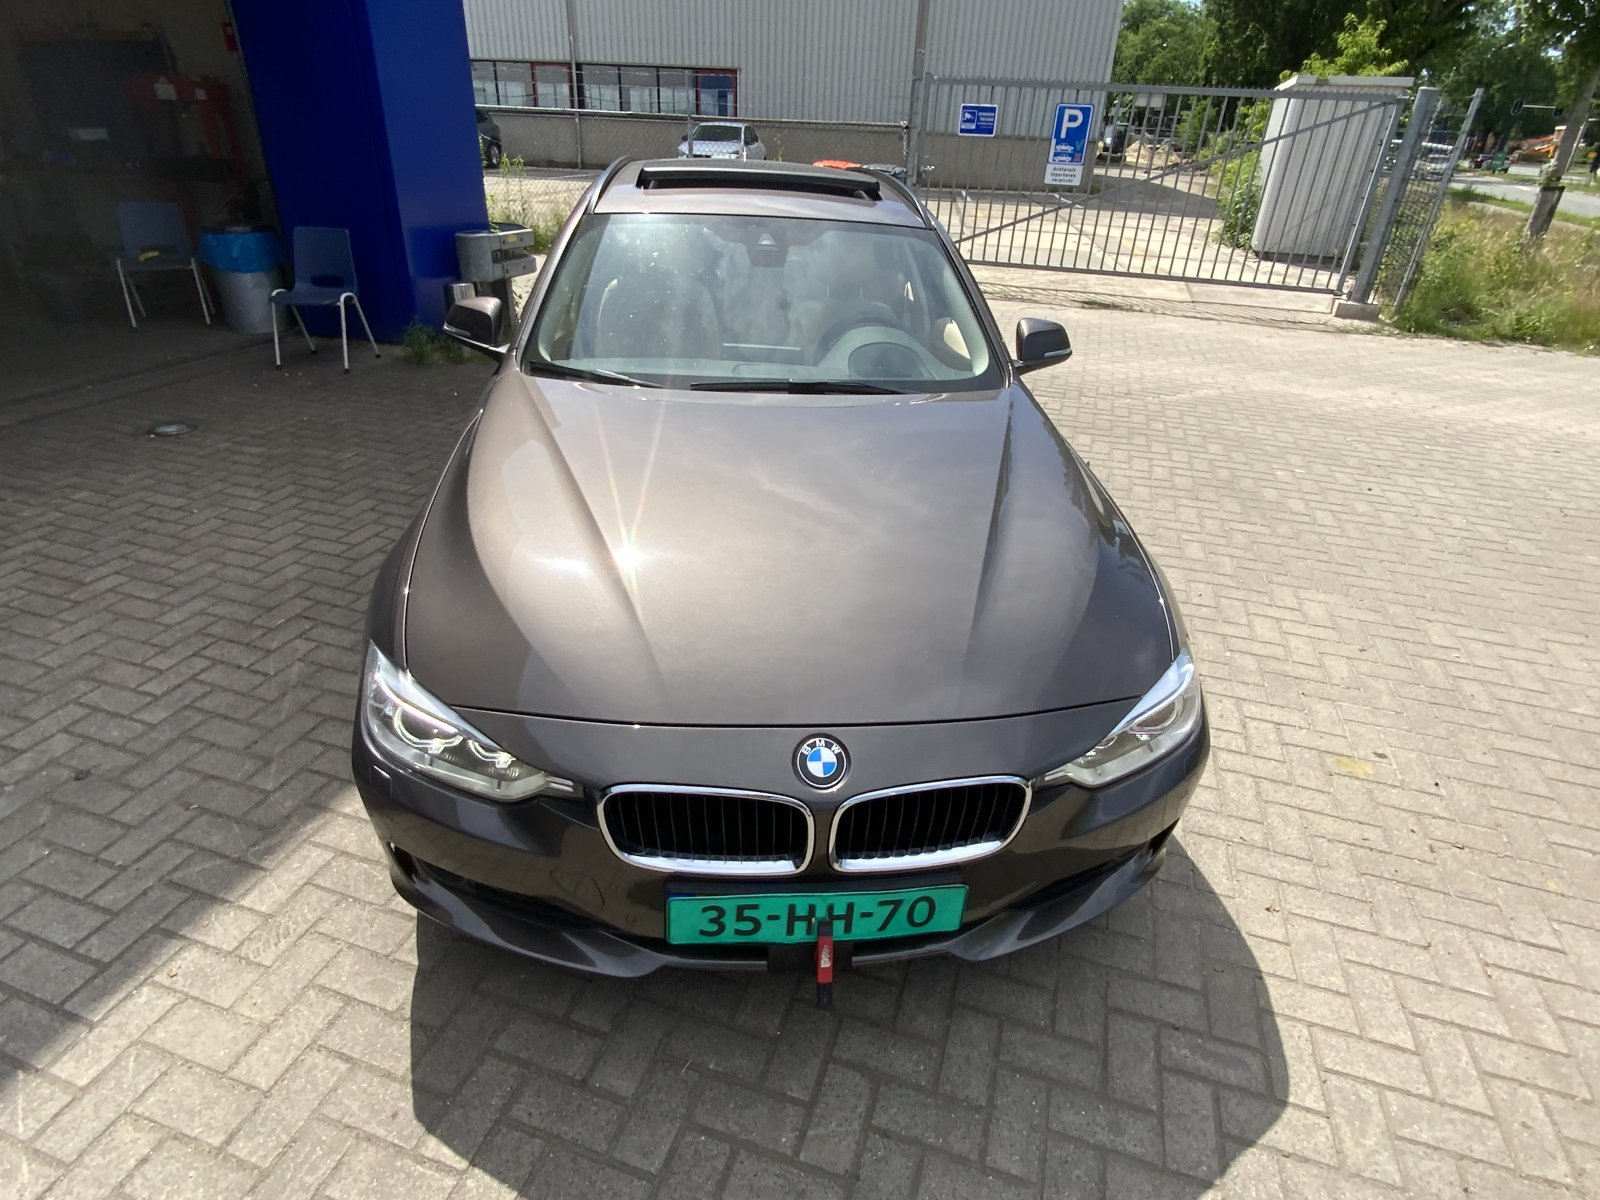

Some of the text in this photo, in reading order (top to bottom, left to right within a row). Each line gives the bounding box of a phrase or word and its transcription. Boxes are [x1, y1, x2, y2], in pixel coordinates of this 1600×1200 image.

[1060, 108, 1083, 139] P
[801, 739, 841, 755] BMW
[698, 896, 937, 937] 35-HH-70
